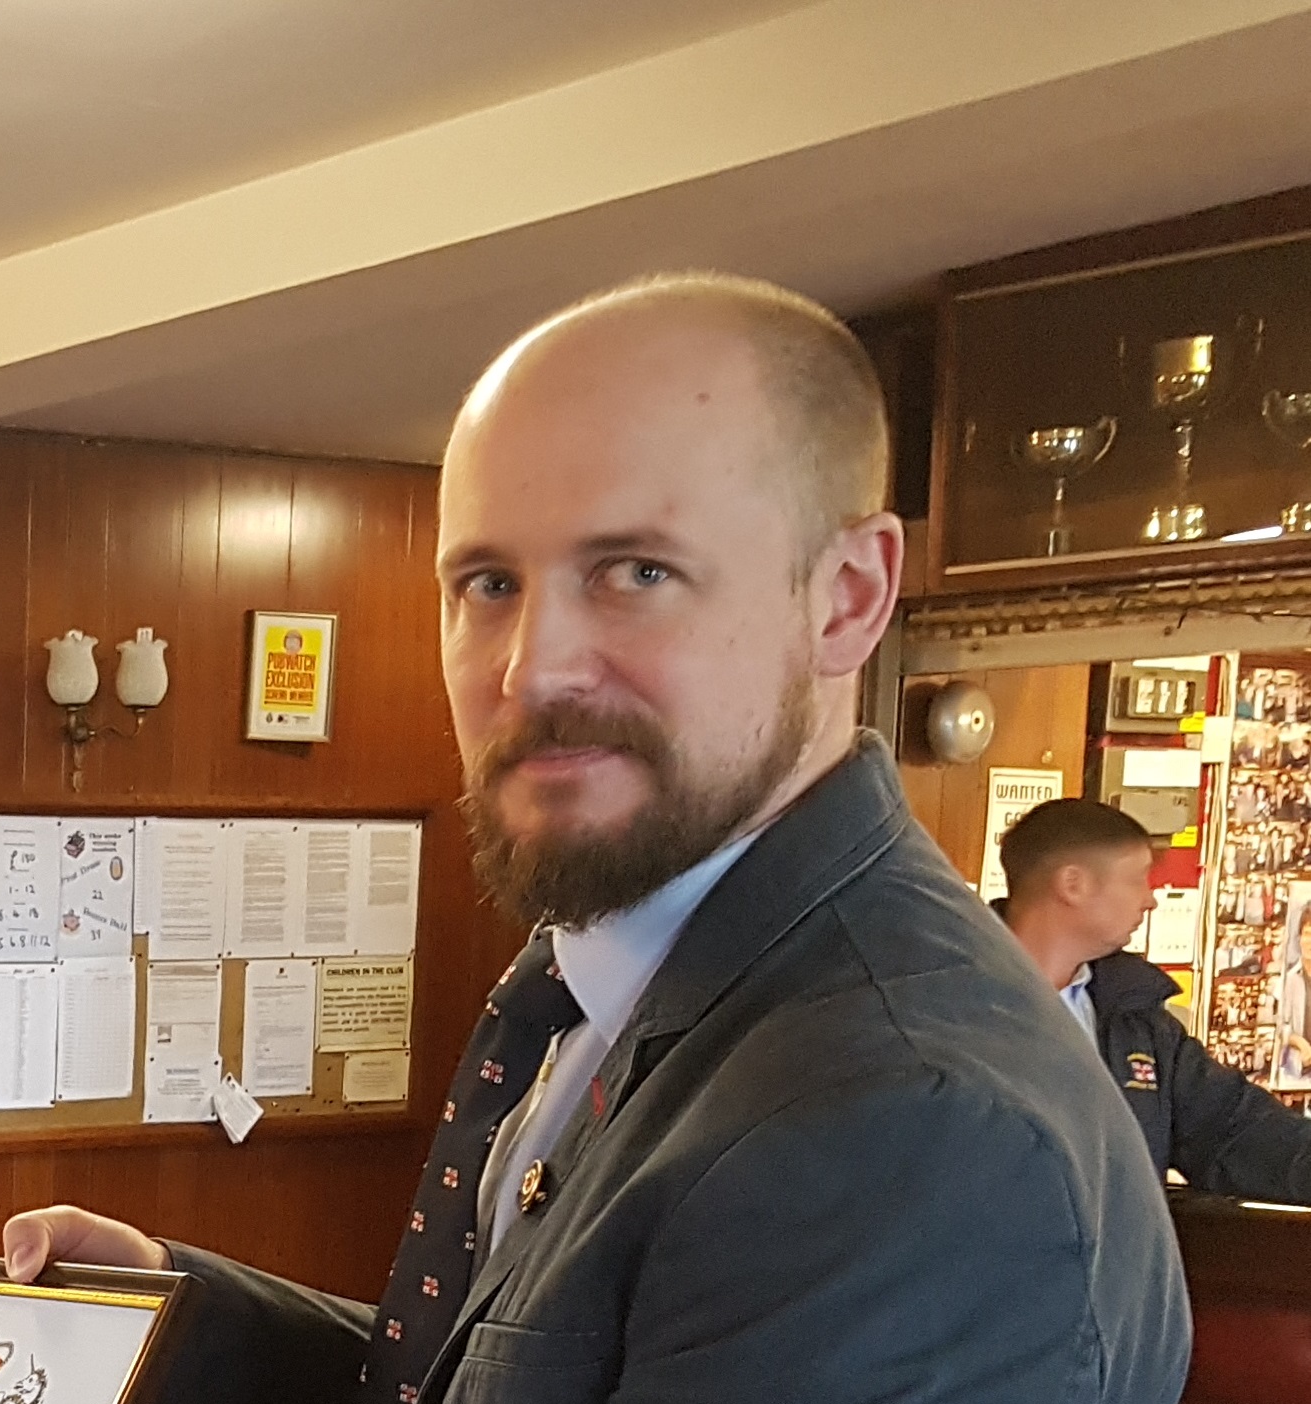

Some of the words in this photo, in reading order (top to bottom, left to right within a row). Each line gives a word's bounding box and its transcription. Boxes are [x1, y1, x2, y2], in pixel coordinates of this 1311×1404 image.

[265, 670, 316, 690] EXCLUSION
[995, 784, 1053, 800] WANTED
[19, 935, 26, 948] 8
[326, 968, 361, 976] CHILDREN
[371, 967, 385, 975] THE
